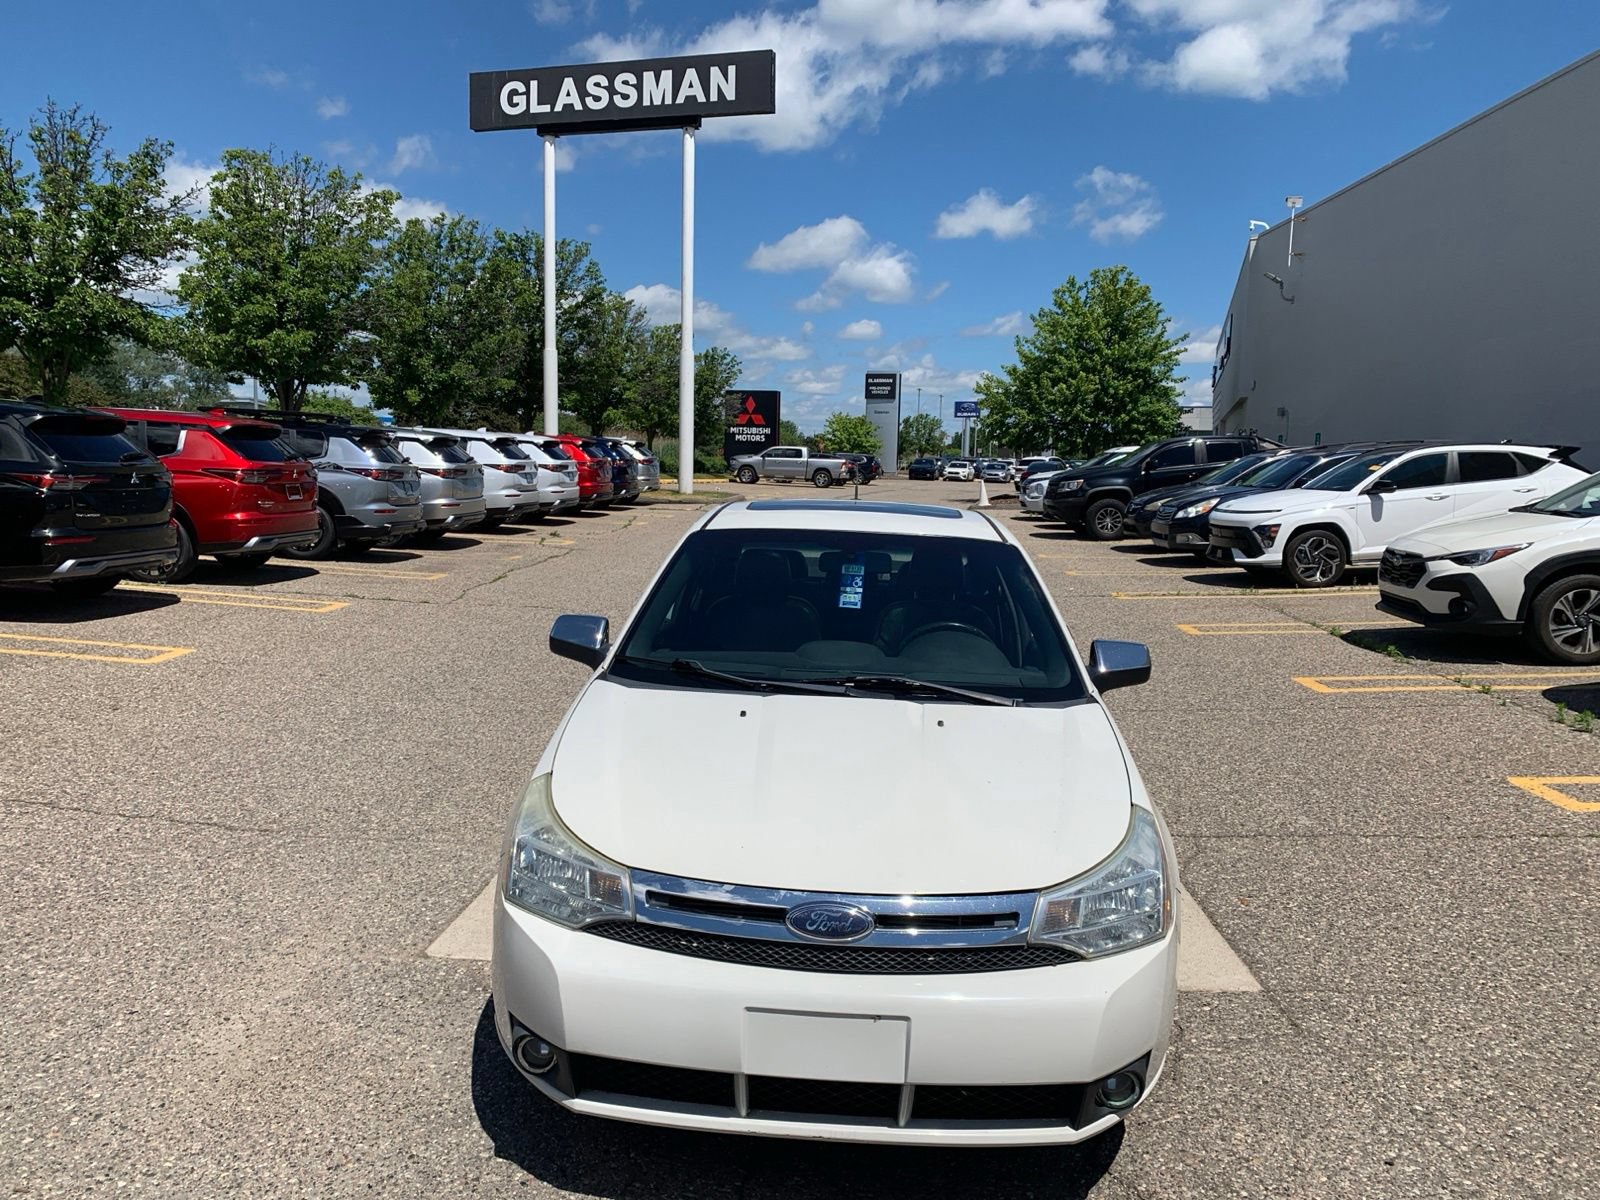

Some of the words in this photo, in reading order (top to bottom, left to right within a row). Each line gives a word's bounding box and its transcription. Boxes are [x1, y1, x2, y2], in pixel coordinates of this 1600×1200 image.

[499, 64, 737, 116] GLASSMAN
[730, 426, 771, 435] MITSUBISHI
[735, 434, 765, 442] MOTORS
[805, 910, 854, 932] Ford
